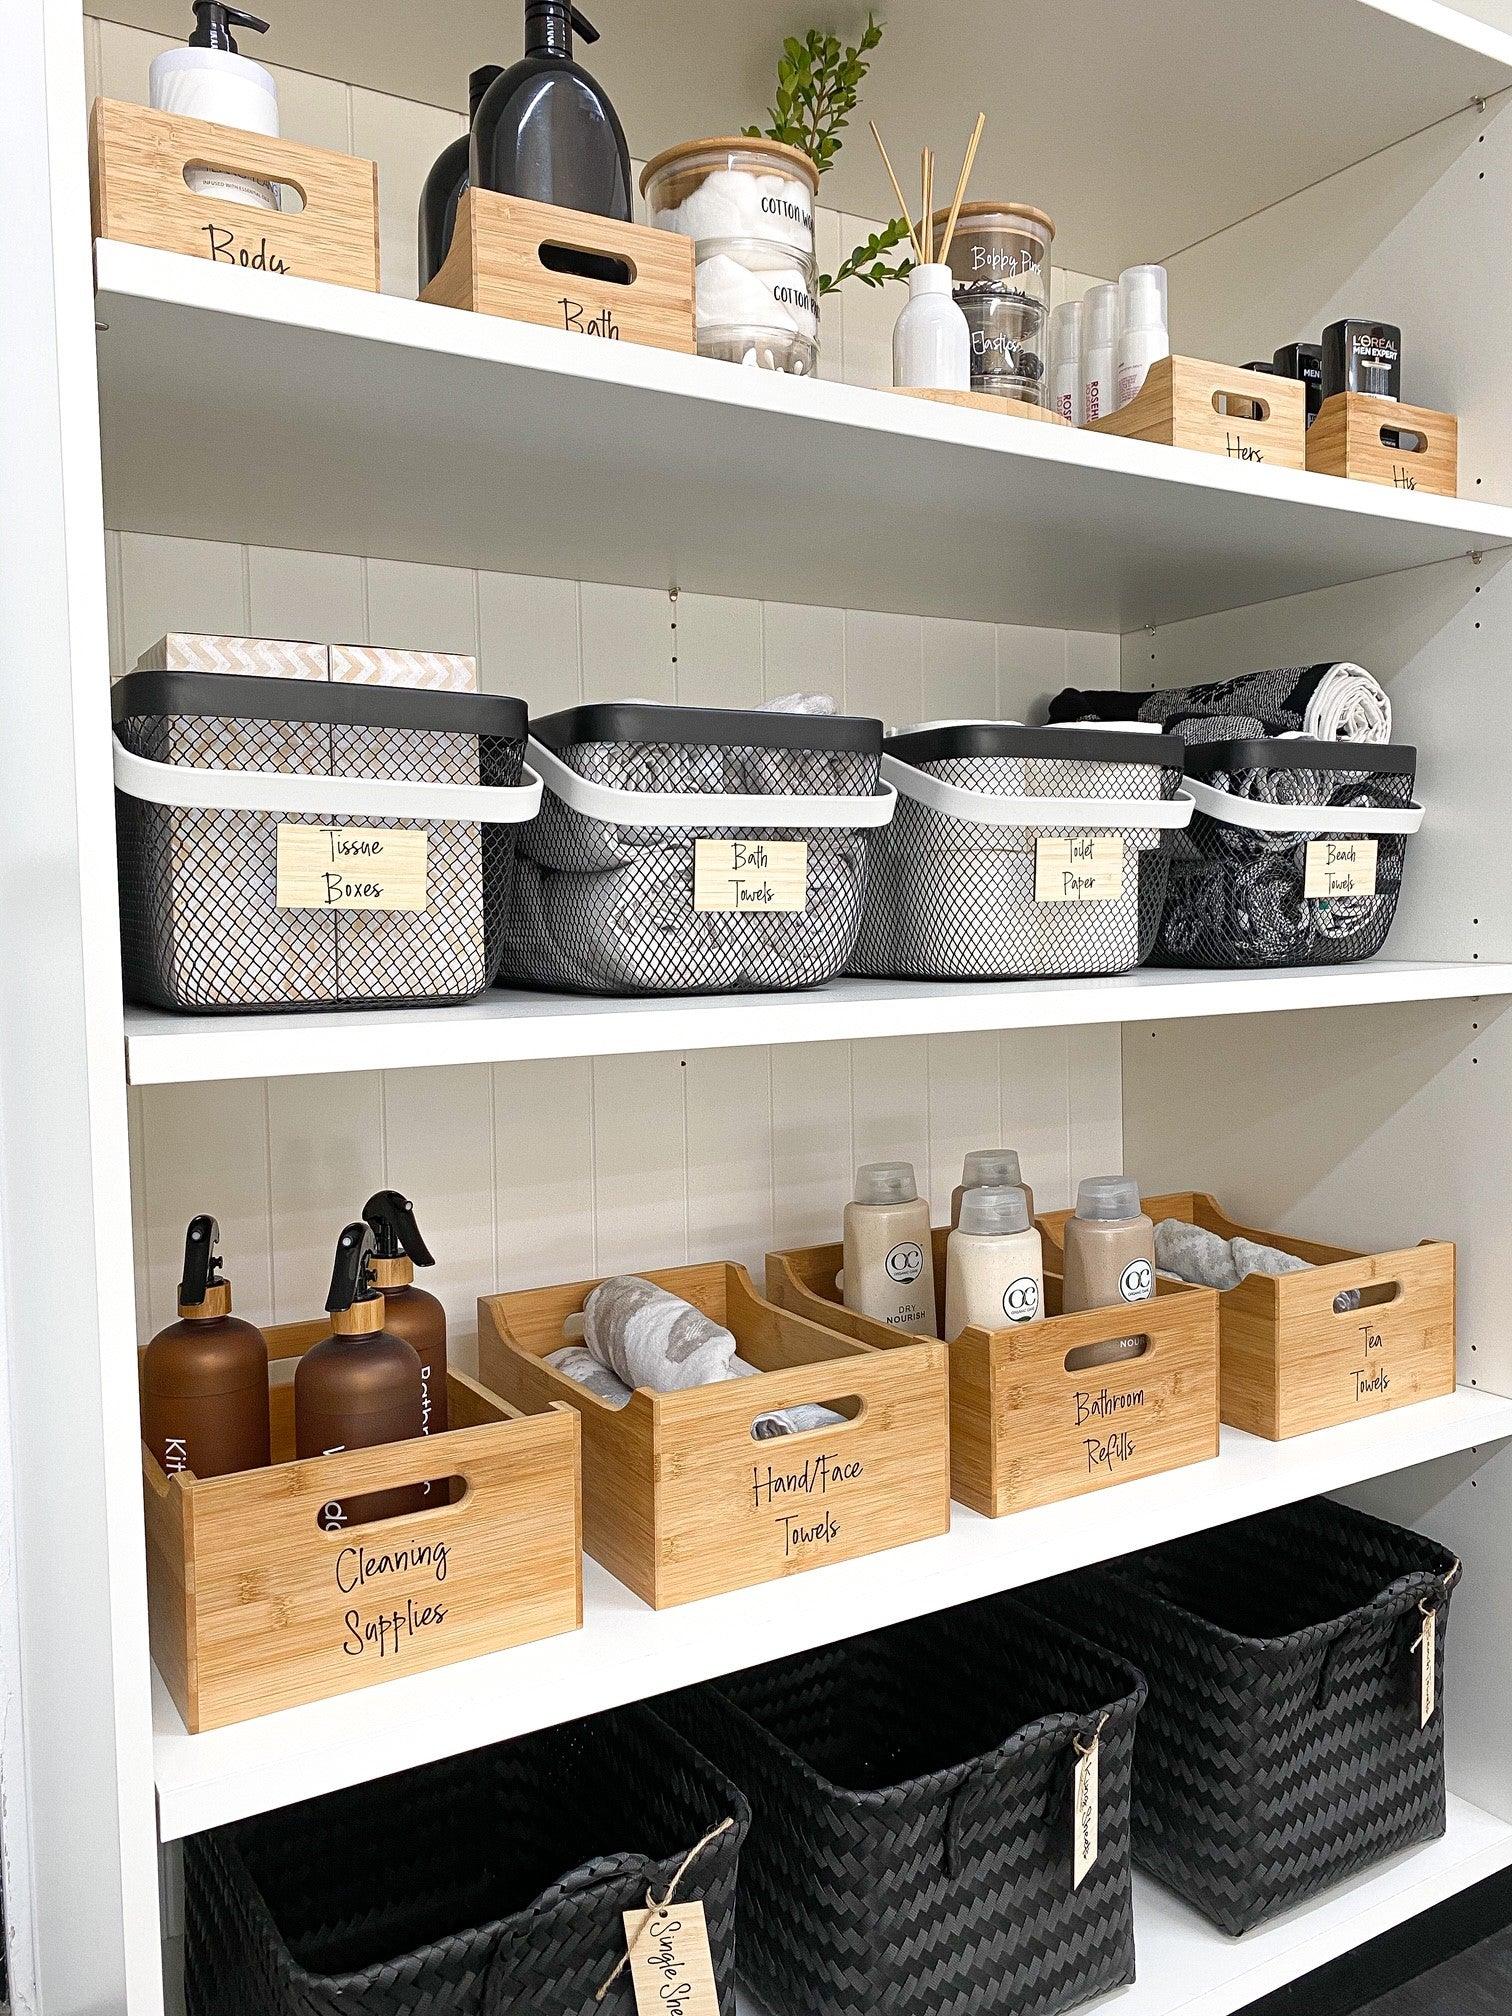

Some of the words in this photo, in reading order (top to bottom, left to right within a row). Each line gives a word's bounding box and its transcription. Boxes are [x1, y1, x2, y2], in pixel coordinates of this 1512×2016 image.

[201, 223, 291, 275] Body
[971, 245, 1018, 278] Bobby
[557, 297, 620, 341] Bath
[971, 330, 1019, 355] Elastics
[1352, 346, 1371, 356] MEN
[1371, 347, 1398, 361] EXPERT
[1303, 368, 1321, 378] MEN
[1226, 431, 1264, 463] Hers
[1393, 464, 1417, 491] His
[319, 829, 384, 862] Tissue
[730, 842, 768, 870] Bath
[1063, 837, 1095, 863] Toilet
[1325, 843, 1356, 866] Beach
[321, 872, 384, 905] Boxes
[728, 879, 775, 908] Towels
[1062, 871, 1096, 900] Paper
[1324, 872, 1356, 895] Towels
[886, 1310, 926, 1324] NOURISH
[898, 1304, 916, 1314] DRY
[1358, 1325, 1383, 1357] Tea
[1349, 1367, 1390, 1402] Towels
[1072, 1388, 1144, 1426] Bathroom
[1082, 1432, 1137, 1473] Refills
[752, 1453, 864, 1507] Hand/Face
[774, 1510, 840, 1556] Towels
[336, 1539, 451, 1593] Cleaning
[343, 1599, 449, 1657] Supplies
[647, 1920, 686, 1981] Single
